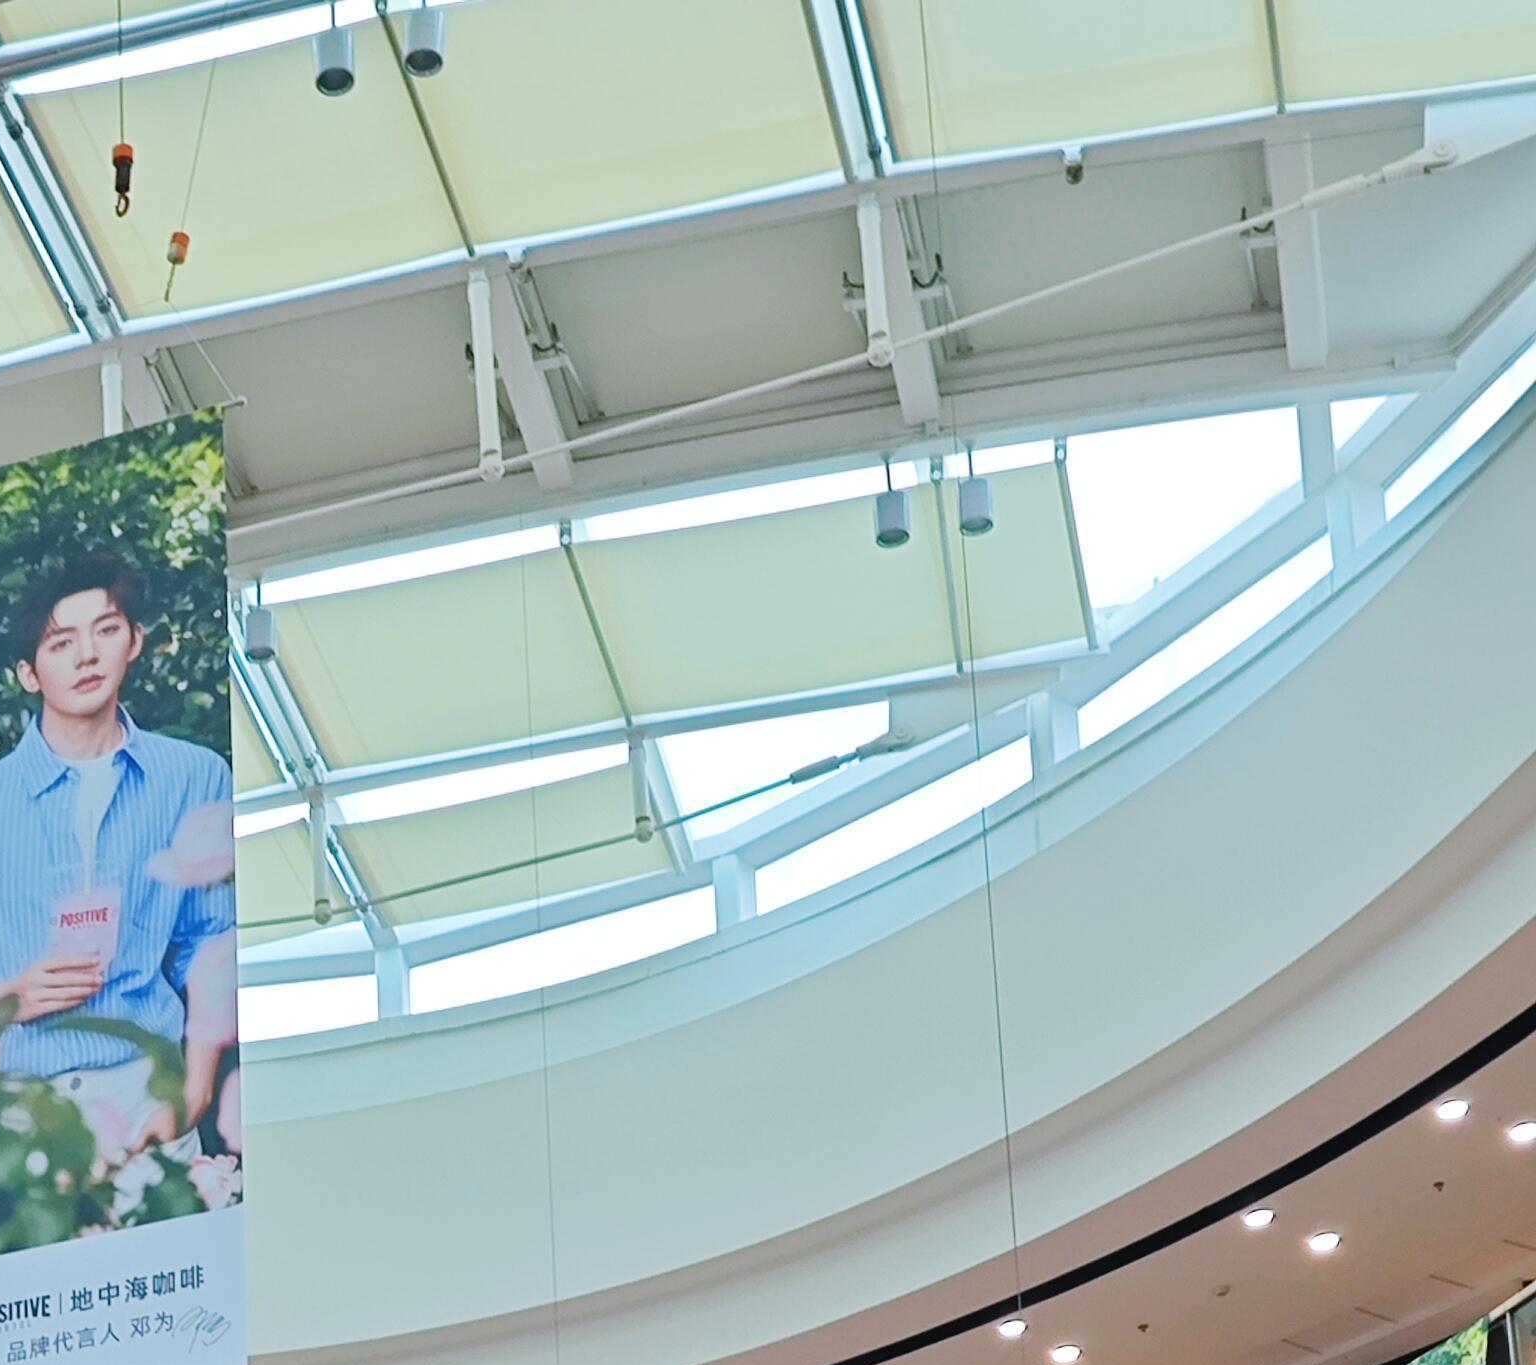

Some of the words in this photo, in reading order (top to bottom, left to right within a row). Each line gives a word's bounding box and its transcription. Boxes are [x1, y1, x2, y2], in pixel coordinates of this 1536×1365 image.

[61, 907, 108, 928] POSITIVE
[70, 1265, 205, 1312] 地中海咖啡
[7, 1326, 120, 1362] 品牌代言人
[129, 1312, 173, 1338] 邓为
